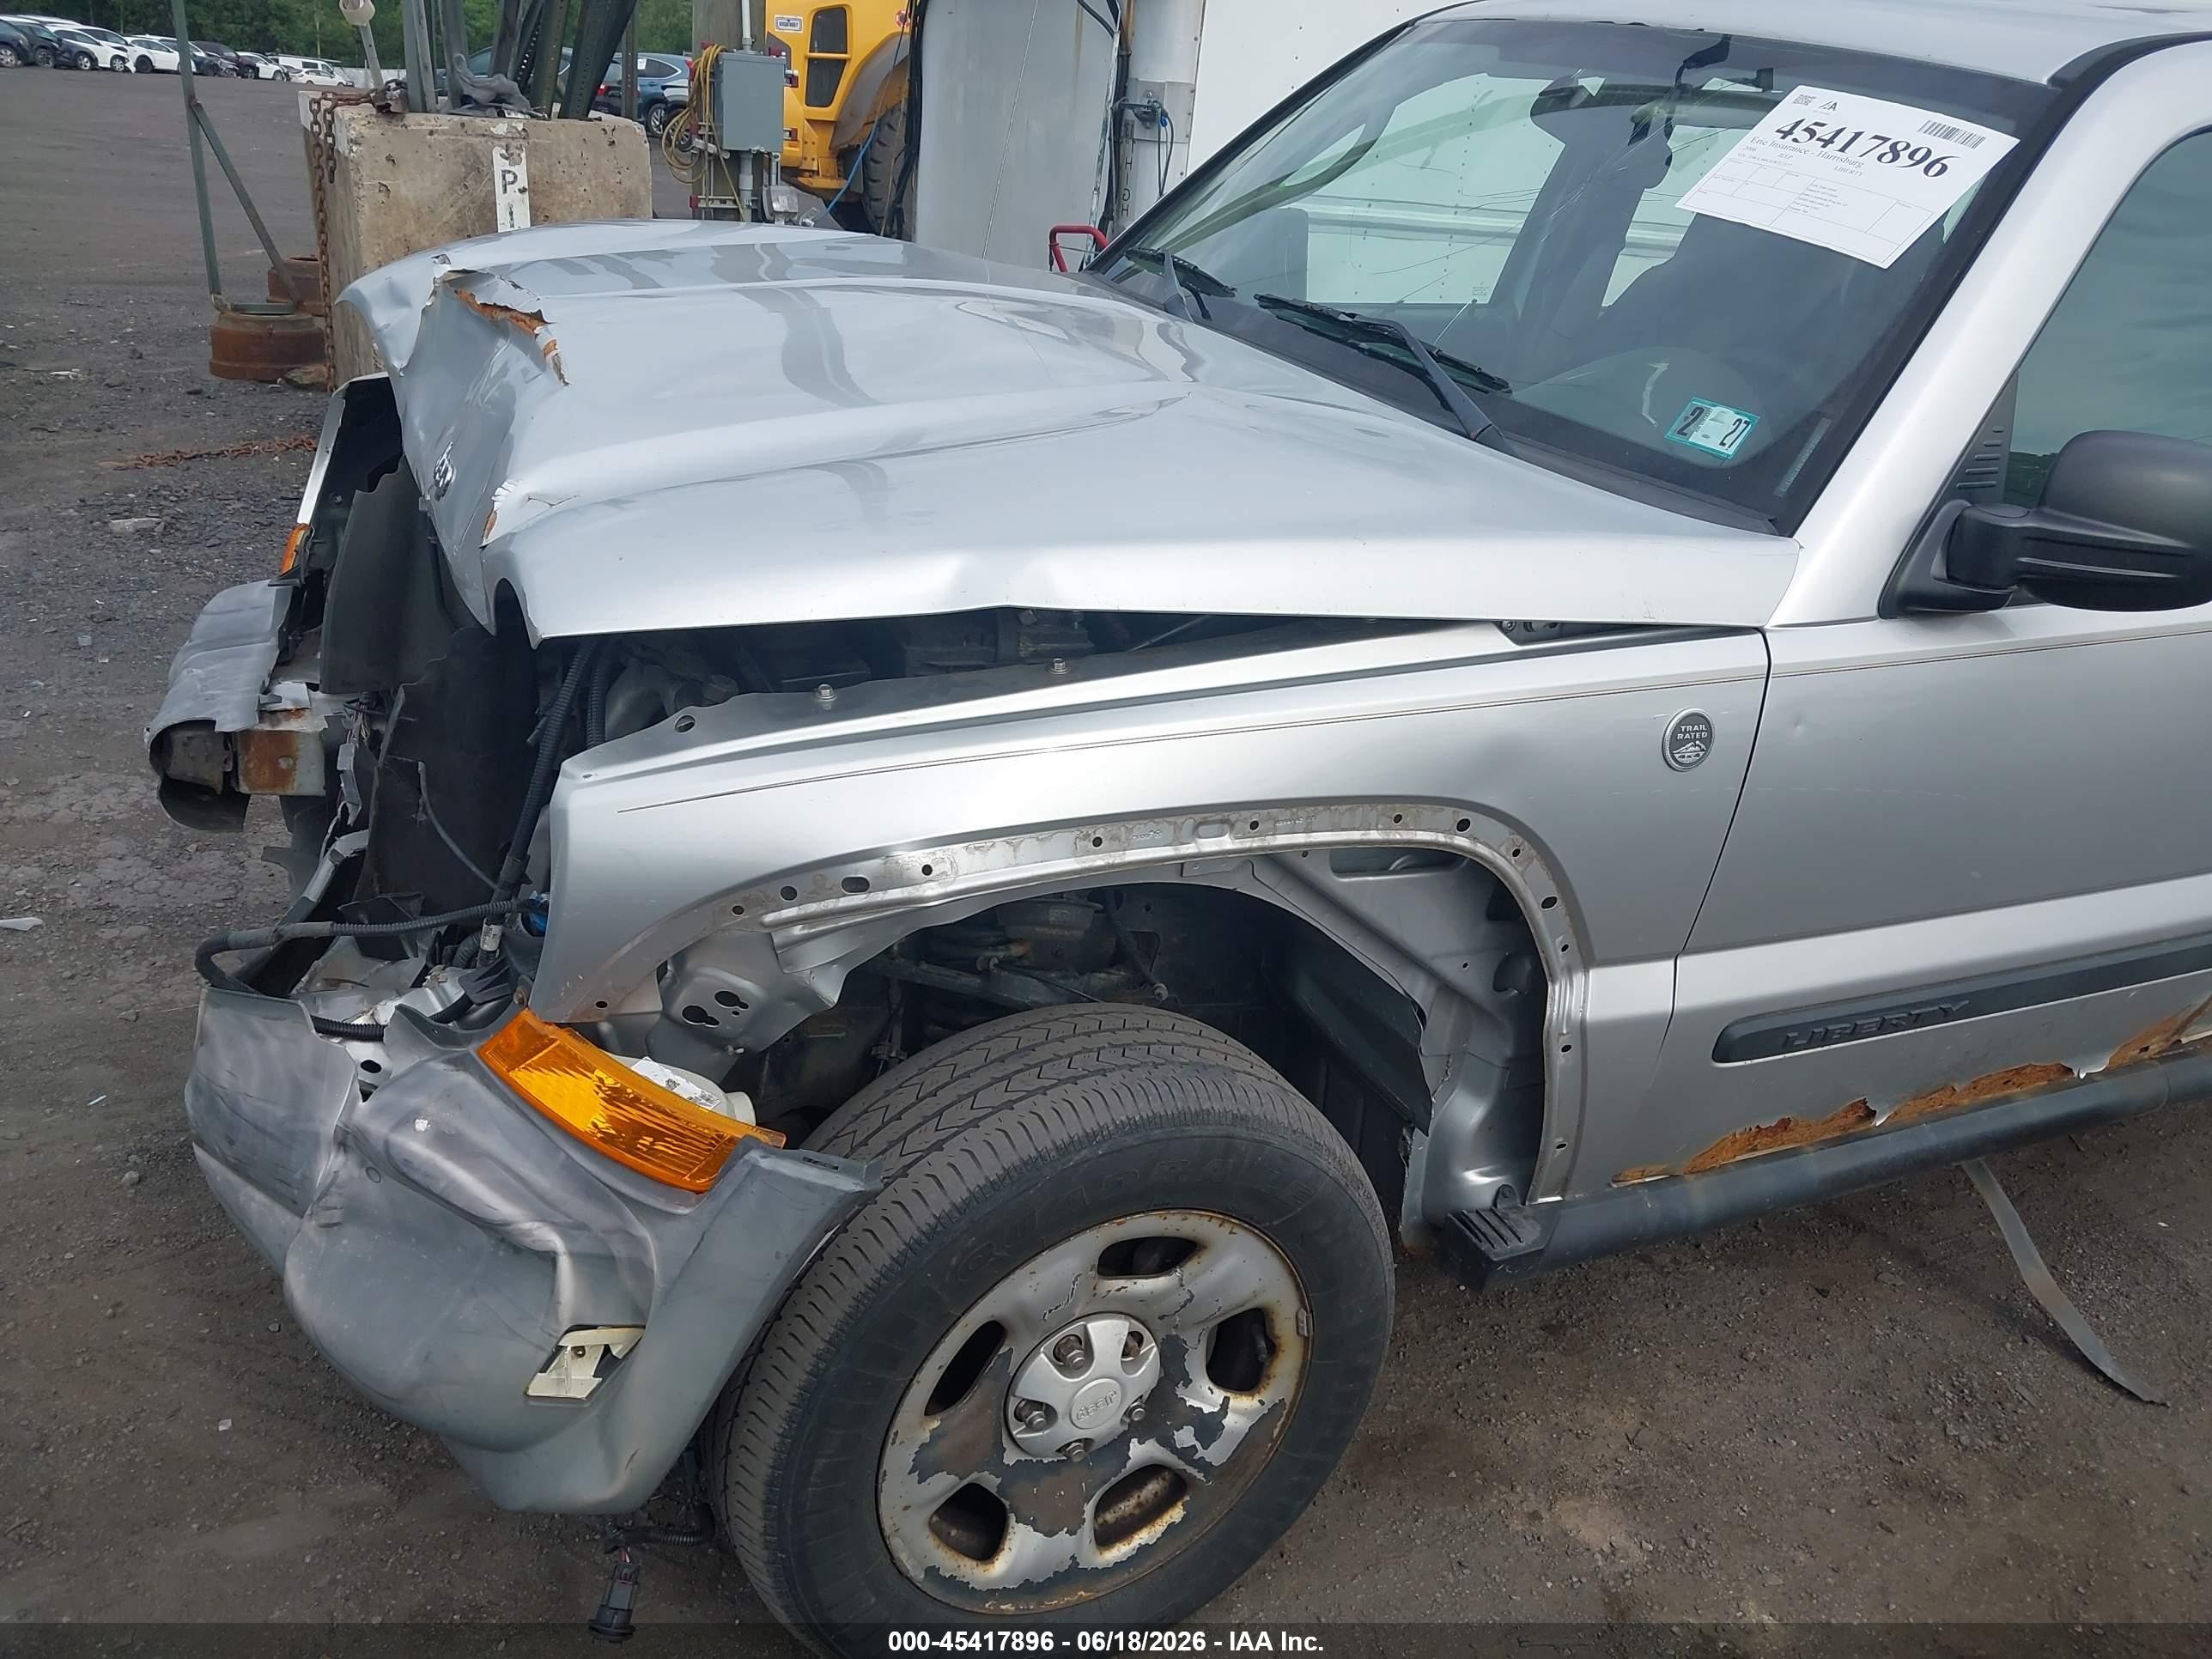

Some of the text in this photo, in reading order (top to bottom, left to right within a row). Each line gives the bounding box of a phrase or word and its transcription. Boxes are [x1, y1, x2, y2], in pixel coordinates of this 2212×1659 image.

[1750, 137, 1766, 146] Erie
[1768, 139, 1810, 155] Insurance
[1817, 149, 1864, 168] Harrisburg
[1774, 118, 1960, 178] 45417896
[1676, 406, 1705, 436] 2
[1719, 418, 1752, 448] 27
[1676, 732, 1708, 740] RATED
[1680, 724, 1707, 732] TRAIL
[1784, 1000, 1970, 1048] LIBERTY
